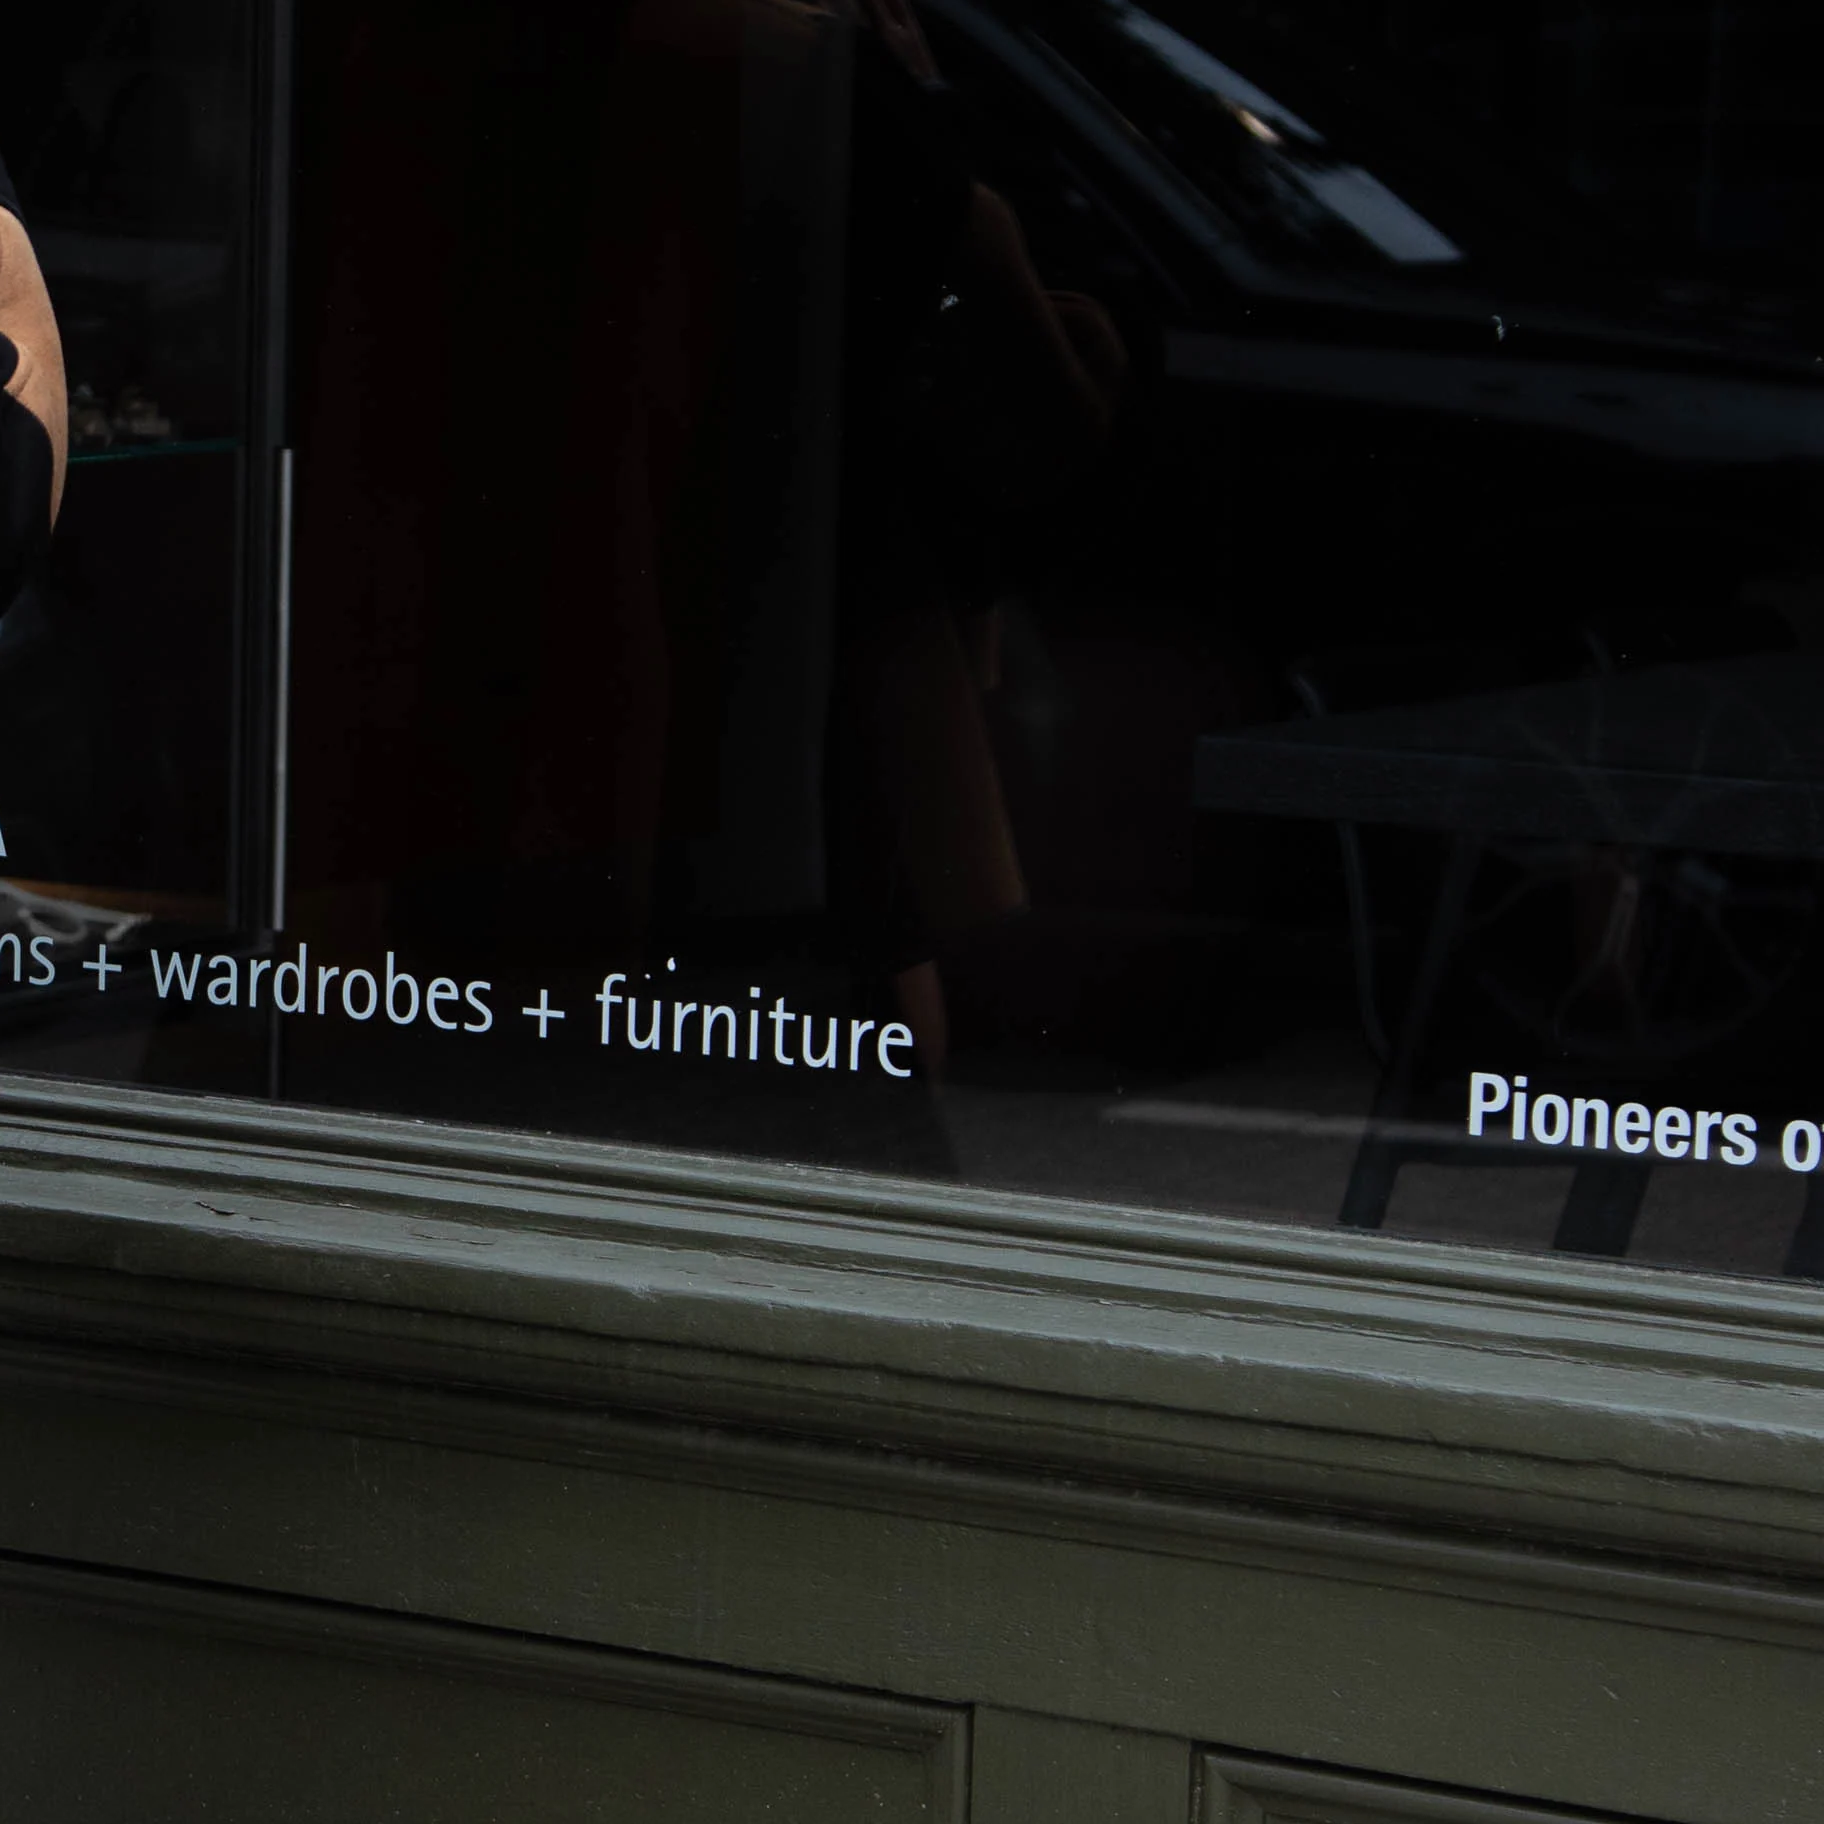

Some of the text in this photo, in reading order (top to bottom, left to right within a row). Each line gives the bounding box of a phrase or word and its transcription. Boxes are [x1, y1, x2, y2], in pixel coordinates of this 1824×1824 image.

[150, 942, 493, 1033] wardrobes
[595, 973, 914, 1077] furniture
[1468, 1071, 1824, 1172] Pioneers o
